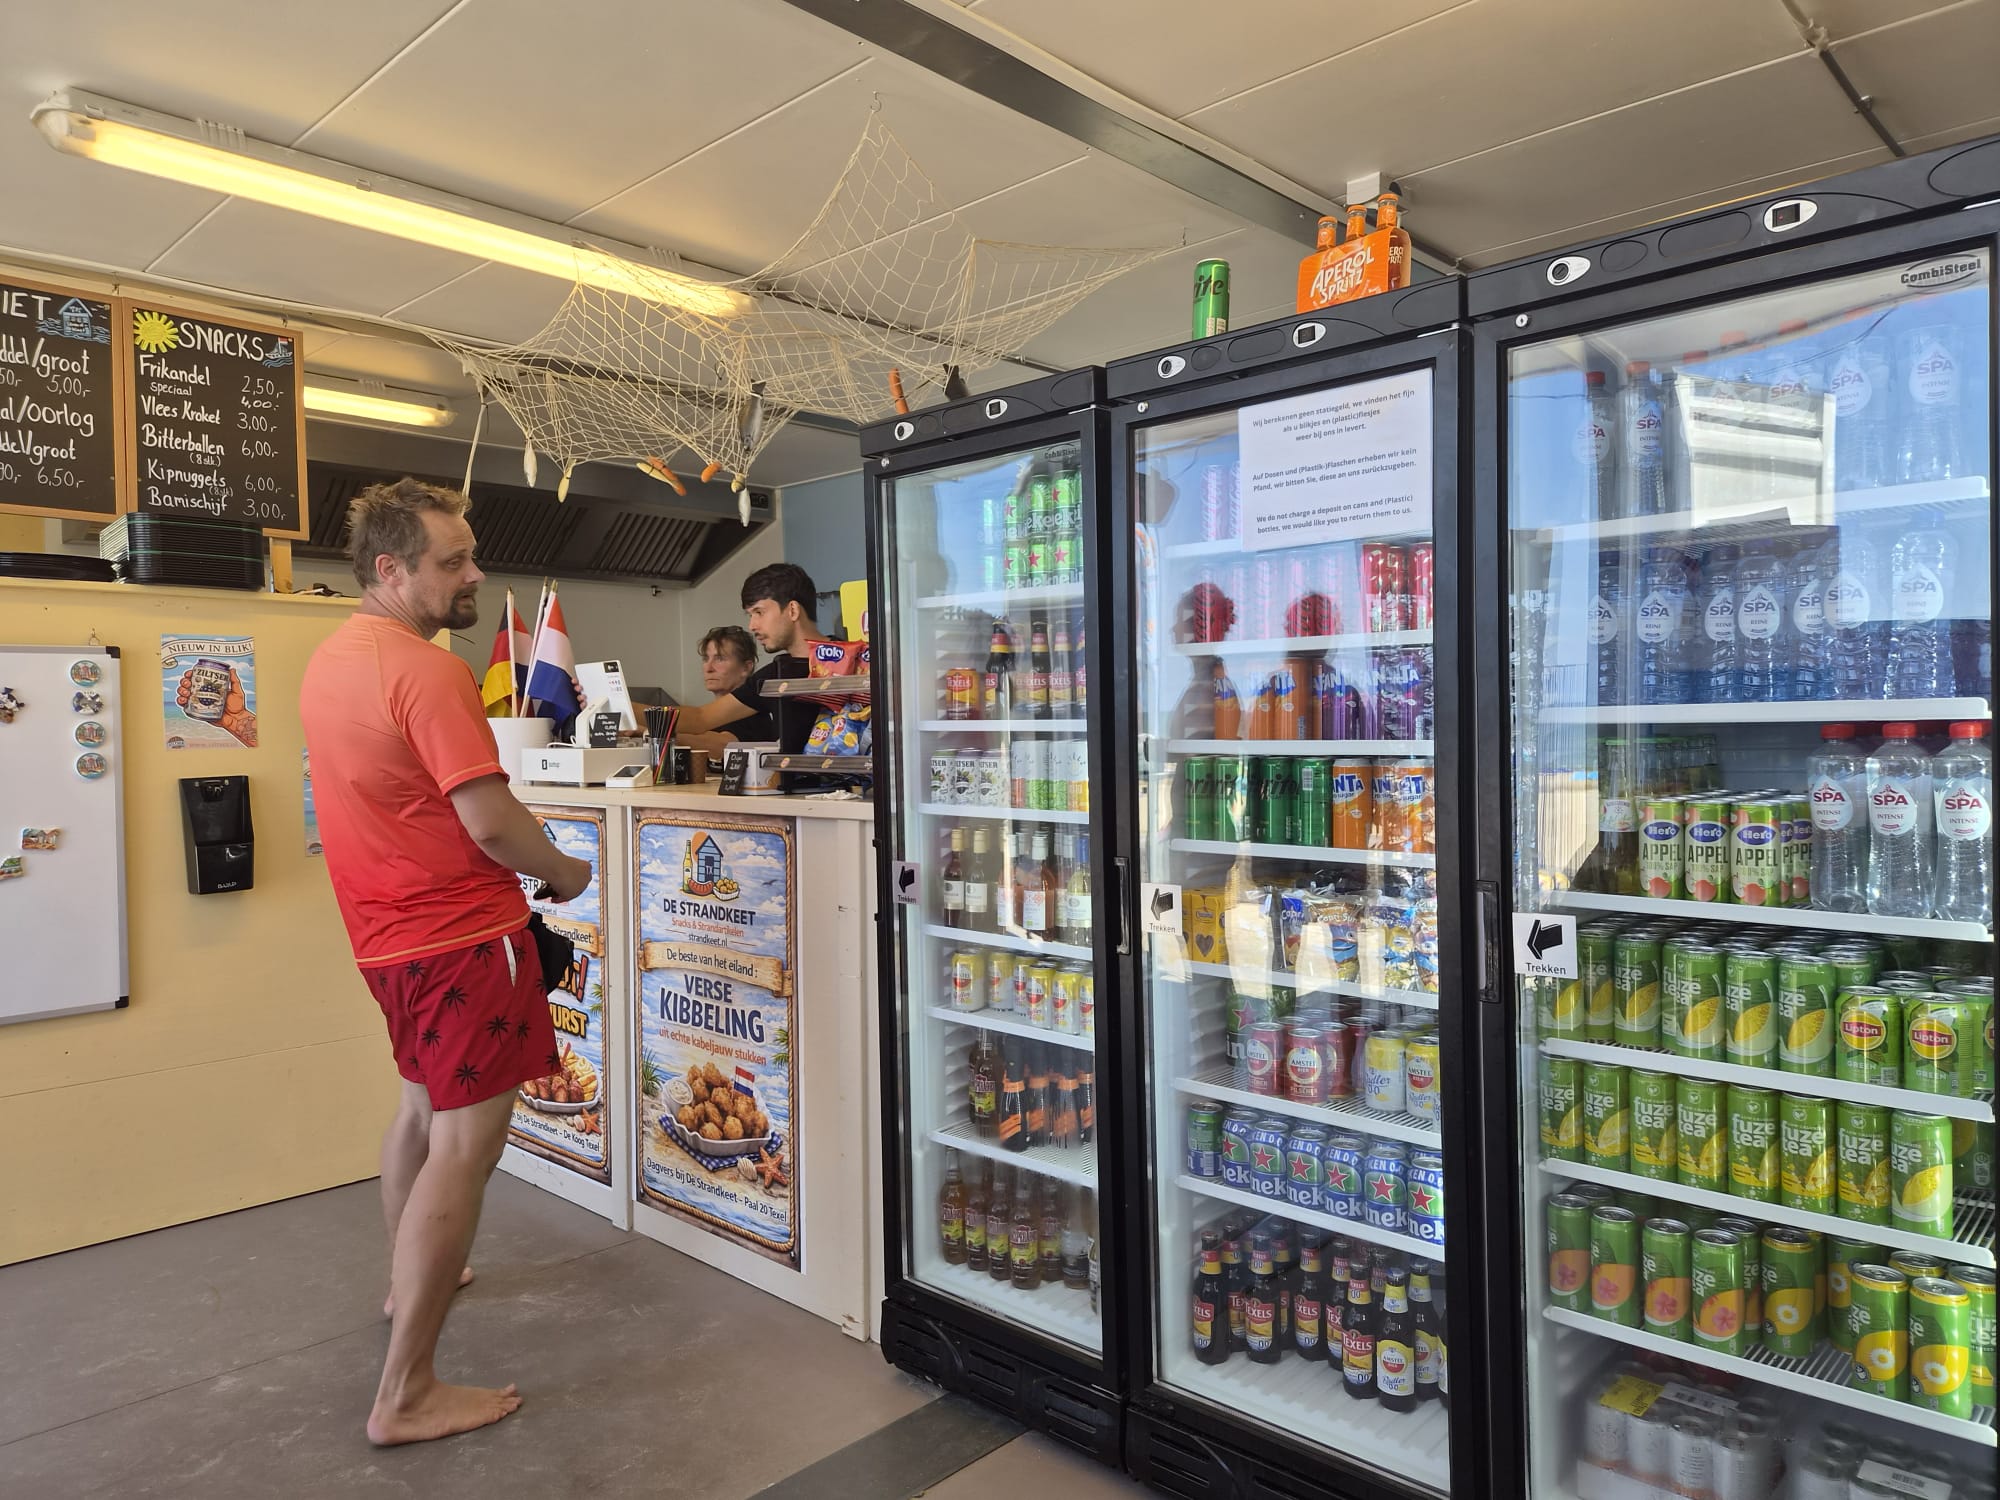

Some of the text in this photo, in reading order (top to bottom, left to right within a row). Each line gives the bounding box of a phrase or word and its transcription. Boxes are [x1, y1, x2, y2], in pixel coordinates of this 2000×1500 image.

[1310, 246, 1375, 298] APEROL
[1900, 258, 1981, 284] CombiSteel
[1320, 268, 1363, 305] SPRITZ
[178, 321, 264, 361] SNACKS
[46, 374, 92, 397] 5,00,-
[139, 354, 284, 398] Frikandel 2,50,-
[150, 381, 193, 396] speciaal
[140, 394, 178, 417] Vlees
[181, 400, 221, 424] Kroket
[1253, 389, 1415, 428] Wij berekenen geen statiegeld, we vinden het fijn
[1299, 420, 1321, 430] blikjes
[1332, 408, 1381, 425] (plastic)flesjes
[141, 423, 279, 458] Bitterballen 6,00,-
[1295, 433, 1312, 441] weer
[1313, 430, 1322, 439] bij
[1323, 429, 1336, 437] ons
[1344, 423, 1367, 433] levert.
[0, 430, 77, 465] del/groot
[1252, 473, 1263, 481] Auf
[1264, 470, 1284, 479] Dosen
[1285, 467, 1298, 476] und
[1357, 453, 1386, 463] erheben
[1387, 451, 1399, 459] wir
[1401, 447, 1417, 456] kein
[38, 466, 85, 488] 6,50,-
[147, 458, 282, 493] Kipnuggets 6,00,-
[1253, 483, 1273, 493] Pfand,
[1273, 481, 1285, 489] wir
[1285, 478, 1305, 487] bitten
[1306, 476, 1318, 484] Sie,
[1319, 473, 1337, 482] diese
[1347, 469, 1360, 477] uns
[1361, 460, 1417, 475] zurückzugeben.
[147, 486, 228, 516] Bamischijf
[1256, 515, 1267, 523] We
[1267, 514, 1276, 522] do
[1276, 512, 1288, 520] not
[1288, 509, 1311, 519] charge
[1317, 504, 1342, 516] deposit
[1352, 501, 1369, 510] cans
[1369, 499, 1384, 507] and
[1384, 494, 1413, 505] (Plastic)
[1257, 526, 1281, 534] bottles,
[1292, 520, 1313, 529] would
[1313, 518, 1326, 527] like
[1326, 517, 1340, 526] you
[1348, 512, 1371, 521] return
[1372, 509, 1391, 518] them
[1401, 507, 1412, 515] us.
[1640, 606, 1670, 617] SPA
[1743, 601, 1776, 613] SPA
[168, 642, 253, 653] NIEUW IN BLIK!
[816, 644, 844, 662] Croky
[1813, 791, 1846, 803] SPA
[1873, 794, 1909, 806] SPA
[1944, 797, 1983, 810] SPA
[1648, 826, 1677, 836] Hero
[1693, 827, 1723, 838] Hero
[1742, 829, 1773, 839] Hero
[1642, 842, 1682, 861] APPEL
[1687, 844, 1729, 864] APPEL
[1736, 847, 1778, 867] APPEL
[663, 898, 756, 926] DE STRANDKEET
[671, 917, 745, 937] Snacks & Strandartikelen
[1148, 922, 1176, 933] Trekken
[688, 933, 728, 947] strandkeet.nl
[666, 948, 754, 977] De beste van het eiland
[1525, 962, 1567, 975] Trekken
[683, 973, 733, 1003] VERSE
[660, 987, 765, 1043] KIBBELING
[1844, 1022, 1878, 1035] Lipton
[1913, 1031, 1949, 1044] Lipton
[659, 1027, 767, 1066] uit echte kabeljauw stukken
[1847, 1060, 1877, 1070] GREEN
[1915, 1069, 1948, 1080] GREEN
[1634, 1096, 1674, 1117] fuze
[1634, 1112, 1665, 1129] tea
[1732, 1114, 1775, 1136] fuze
[523, 1115, 531, 1125] De
[531, 1117, 558, 1136] Strandkeet
[563, 1130, 571, 1140] De
[571, 1132, 585, 1149] Koog
[585, 1138, 600, 1152] Texel
[1733, 1130, 1766, 1148] tea
[1838, 1127, 1884, 1152] fuze
[1840, 1145, 1872, 1165] tea
[646, 1157, 787, 1222] Dagvers bij De Strandkeet Paal 20 Texel
[1245, 1300, 1272, 1319] TEXELS
[1342, 1332, 1372, 1351] TEXELS
